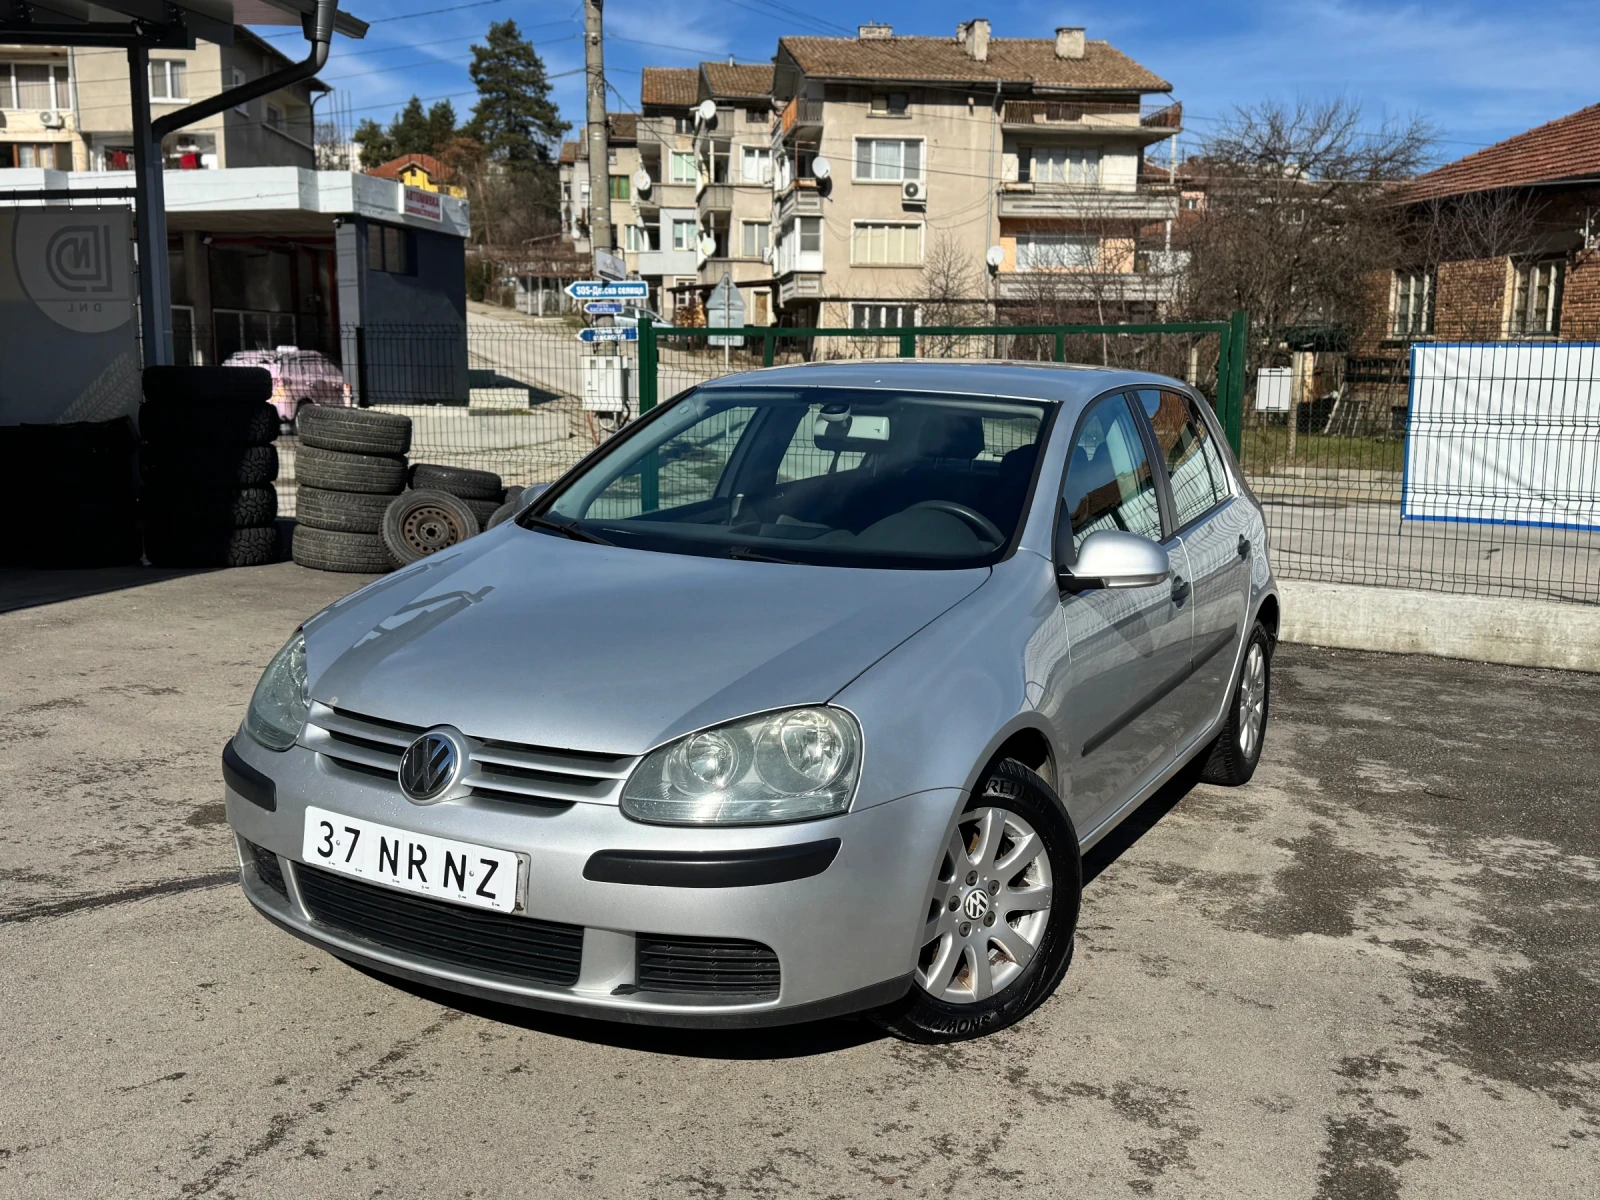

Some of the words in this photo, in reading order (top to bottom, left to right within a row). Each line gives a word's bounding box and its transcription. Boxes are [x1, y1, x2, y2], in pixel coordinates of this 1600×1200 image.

[317, 820, 361, 863] 37
[378, 835, 428, 883] NR
[443, 850, 499, 900] NZ
